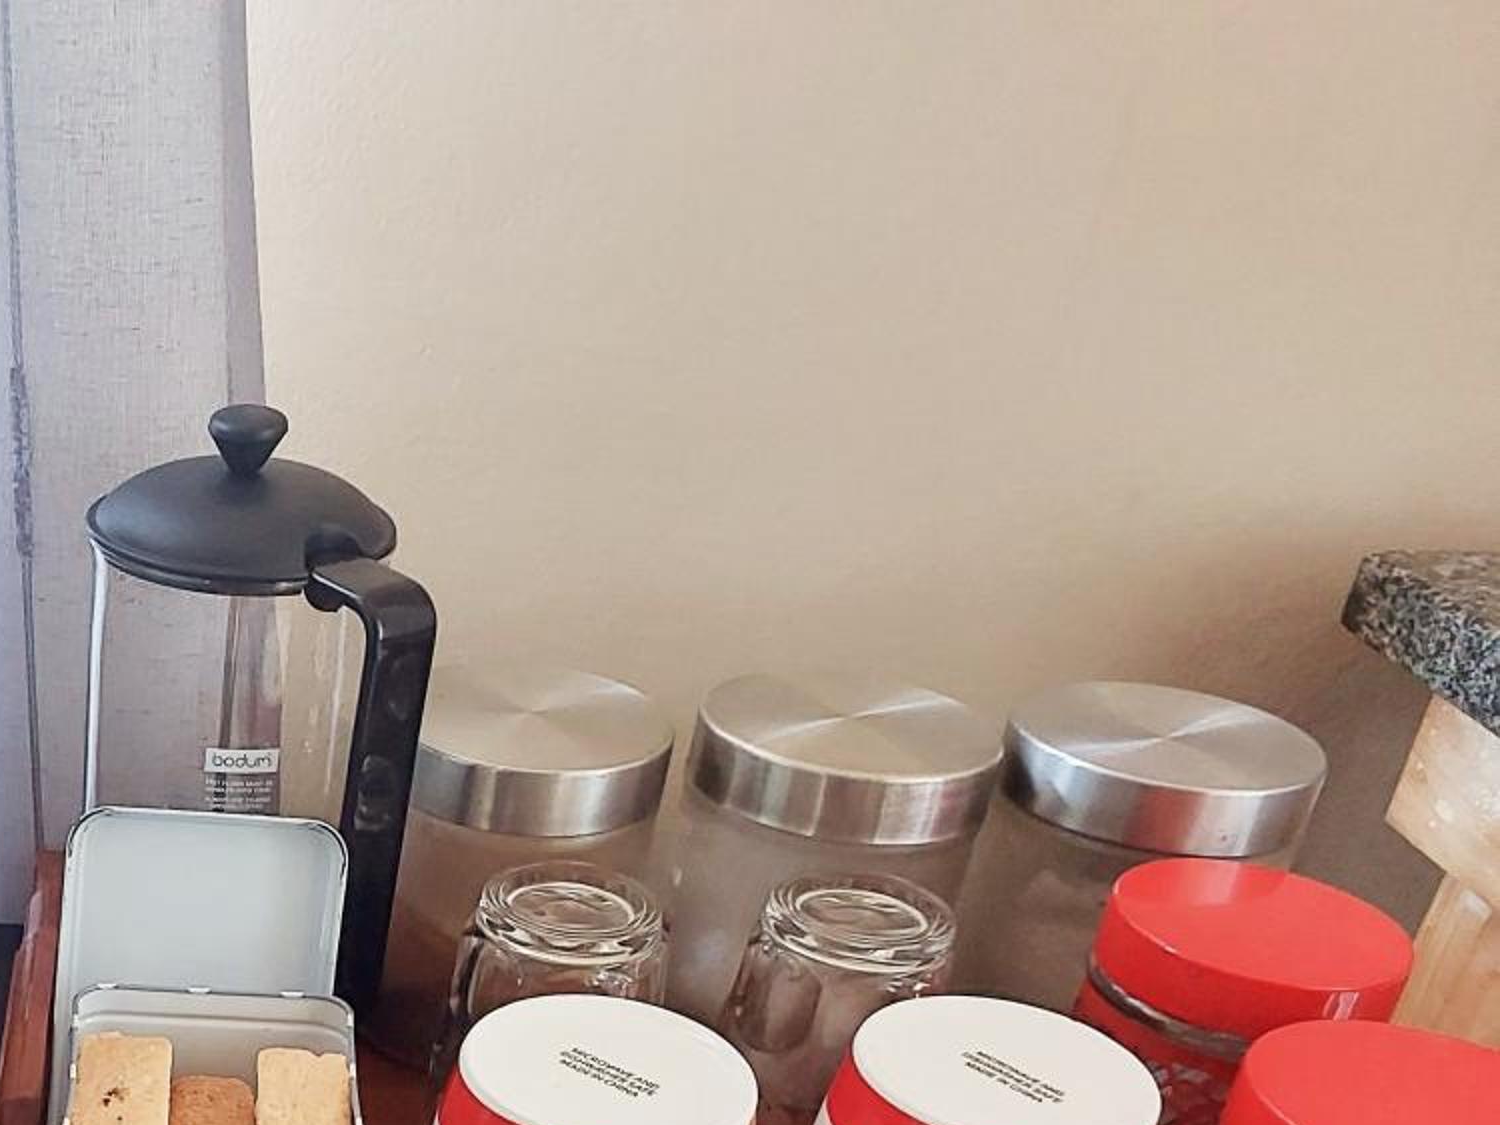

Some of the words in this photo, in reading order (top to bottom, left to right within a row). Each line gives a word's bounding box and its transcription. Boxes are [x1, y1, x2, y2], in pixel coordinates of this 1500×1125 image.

[212, 752, 271, 768] bodum
[571, 1047, 634, 1077] MICROWAVE
[634, 1076, 660, 1088] AND
[965, 1060, 997, 1078] MADE
[604, 1079, 638, 1096] CHINA
